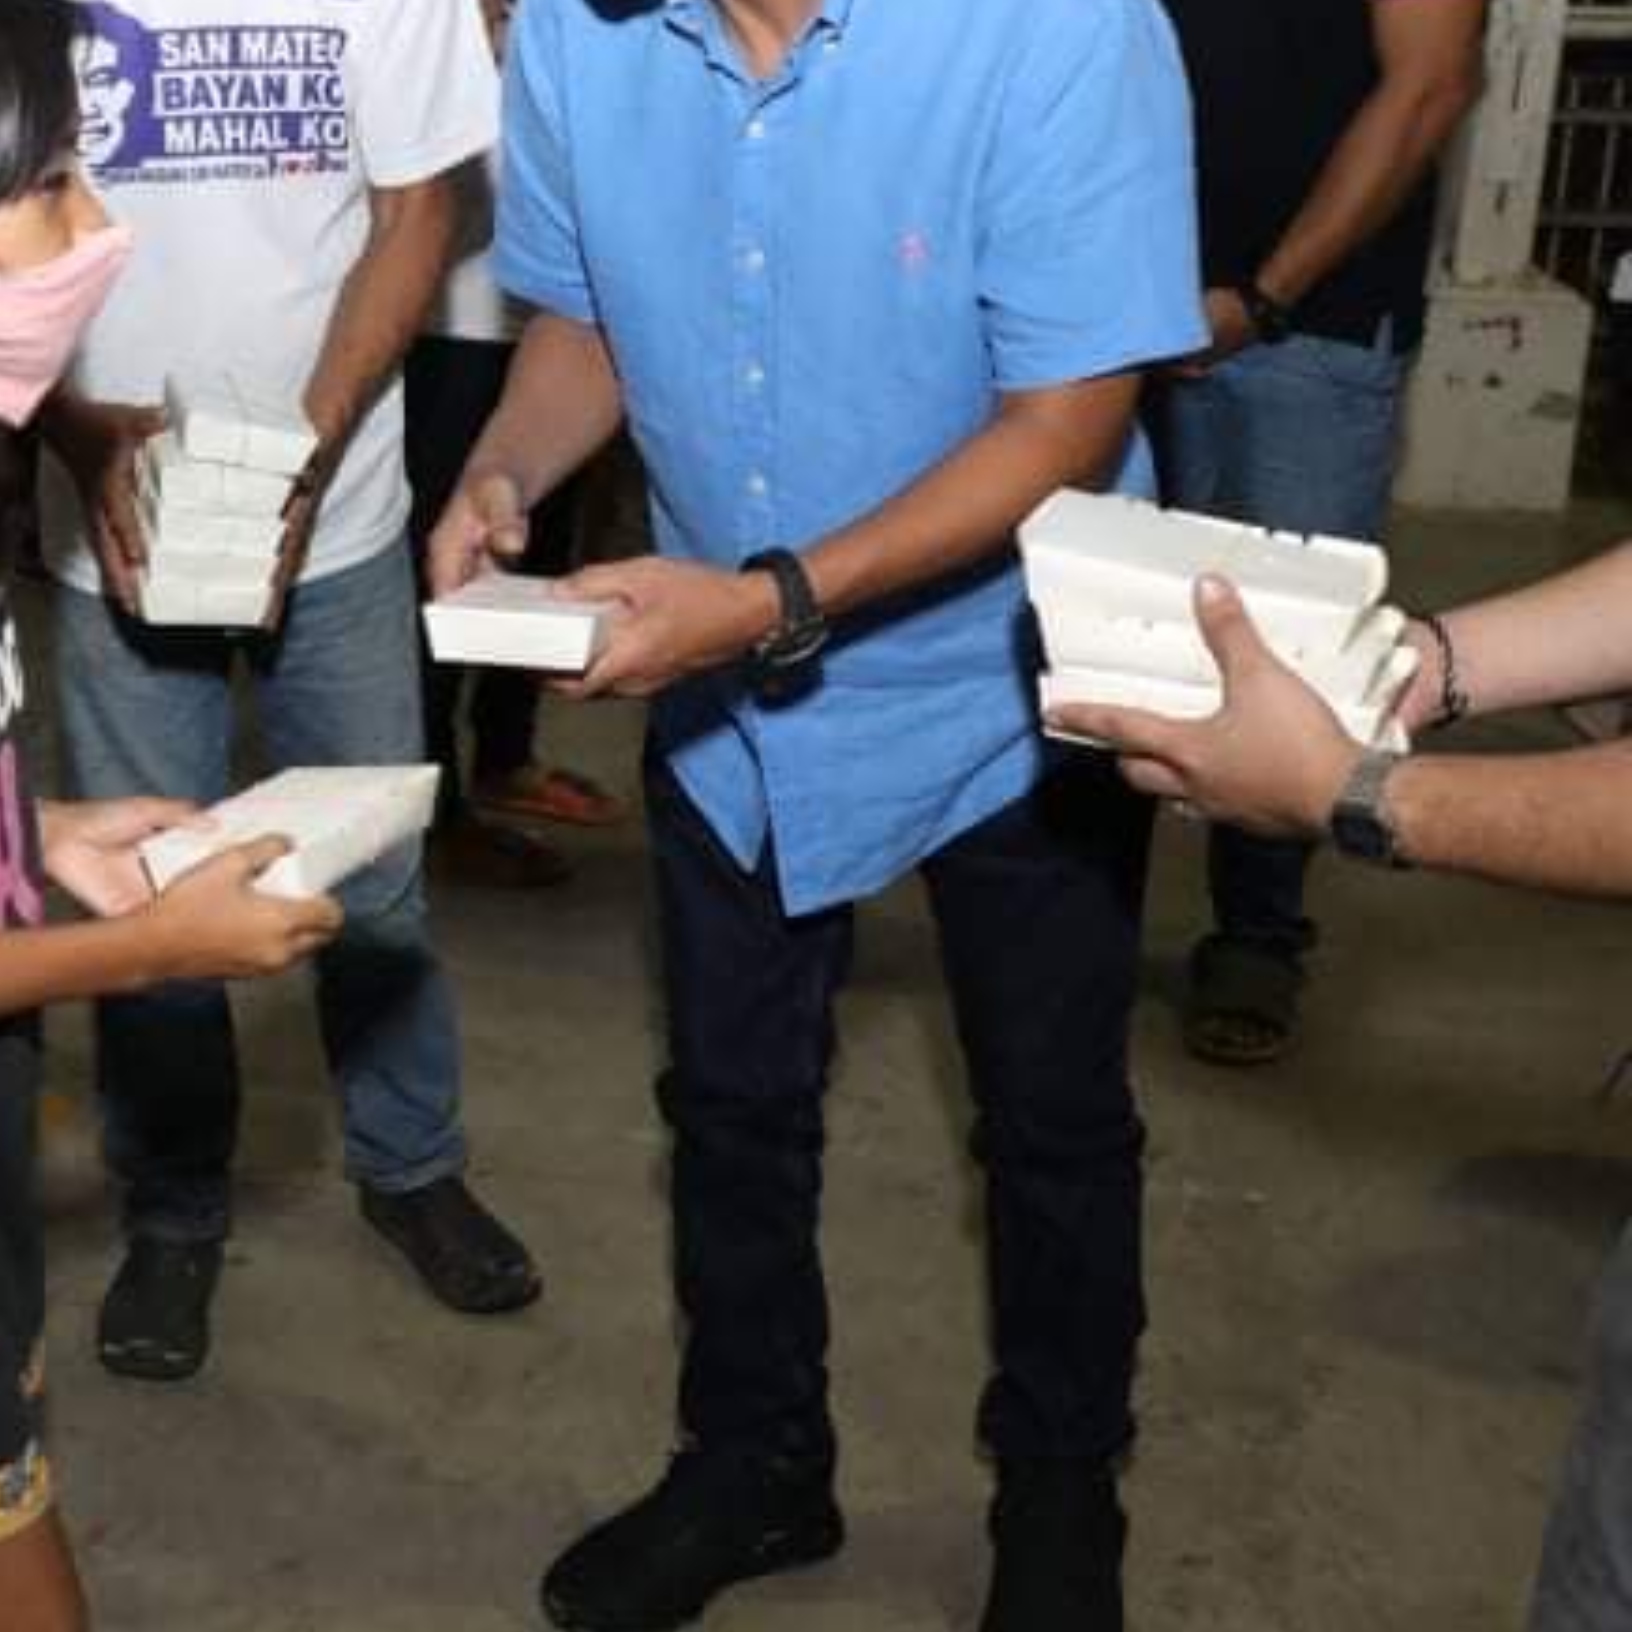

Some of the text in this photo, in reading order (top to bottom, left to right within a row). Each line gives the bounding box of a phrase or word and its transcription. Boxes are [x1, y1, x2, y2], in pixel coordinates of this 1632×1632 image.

[160, 29, 232, 67] SAN
[161, 73, 287, 111] BAYAN
[164, 115, 348, 155] MAHAL KO
